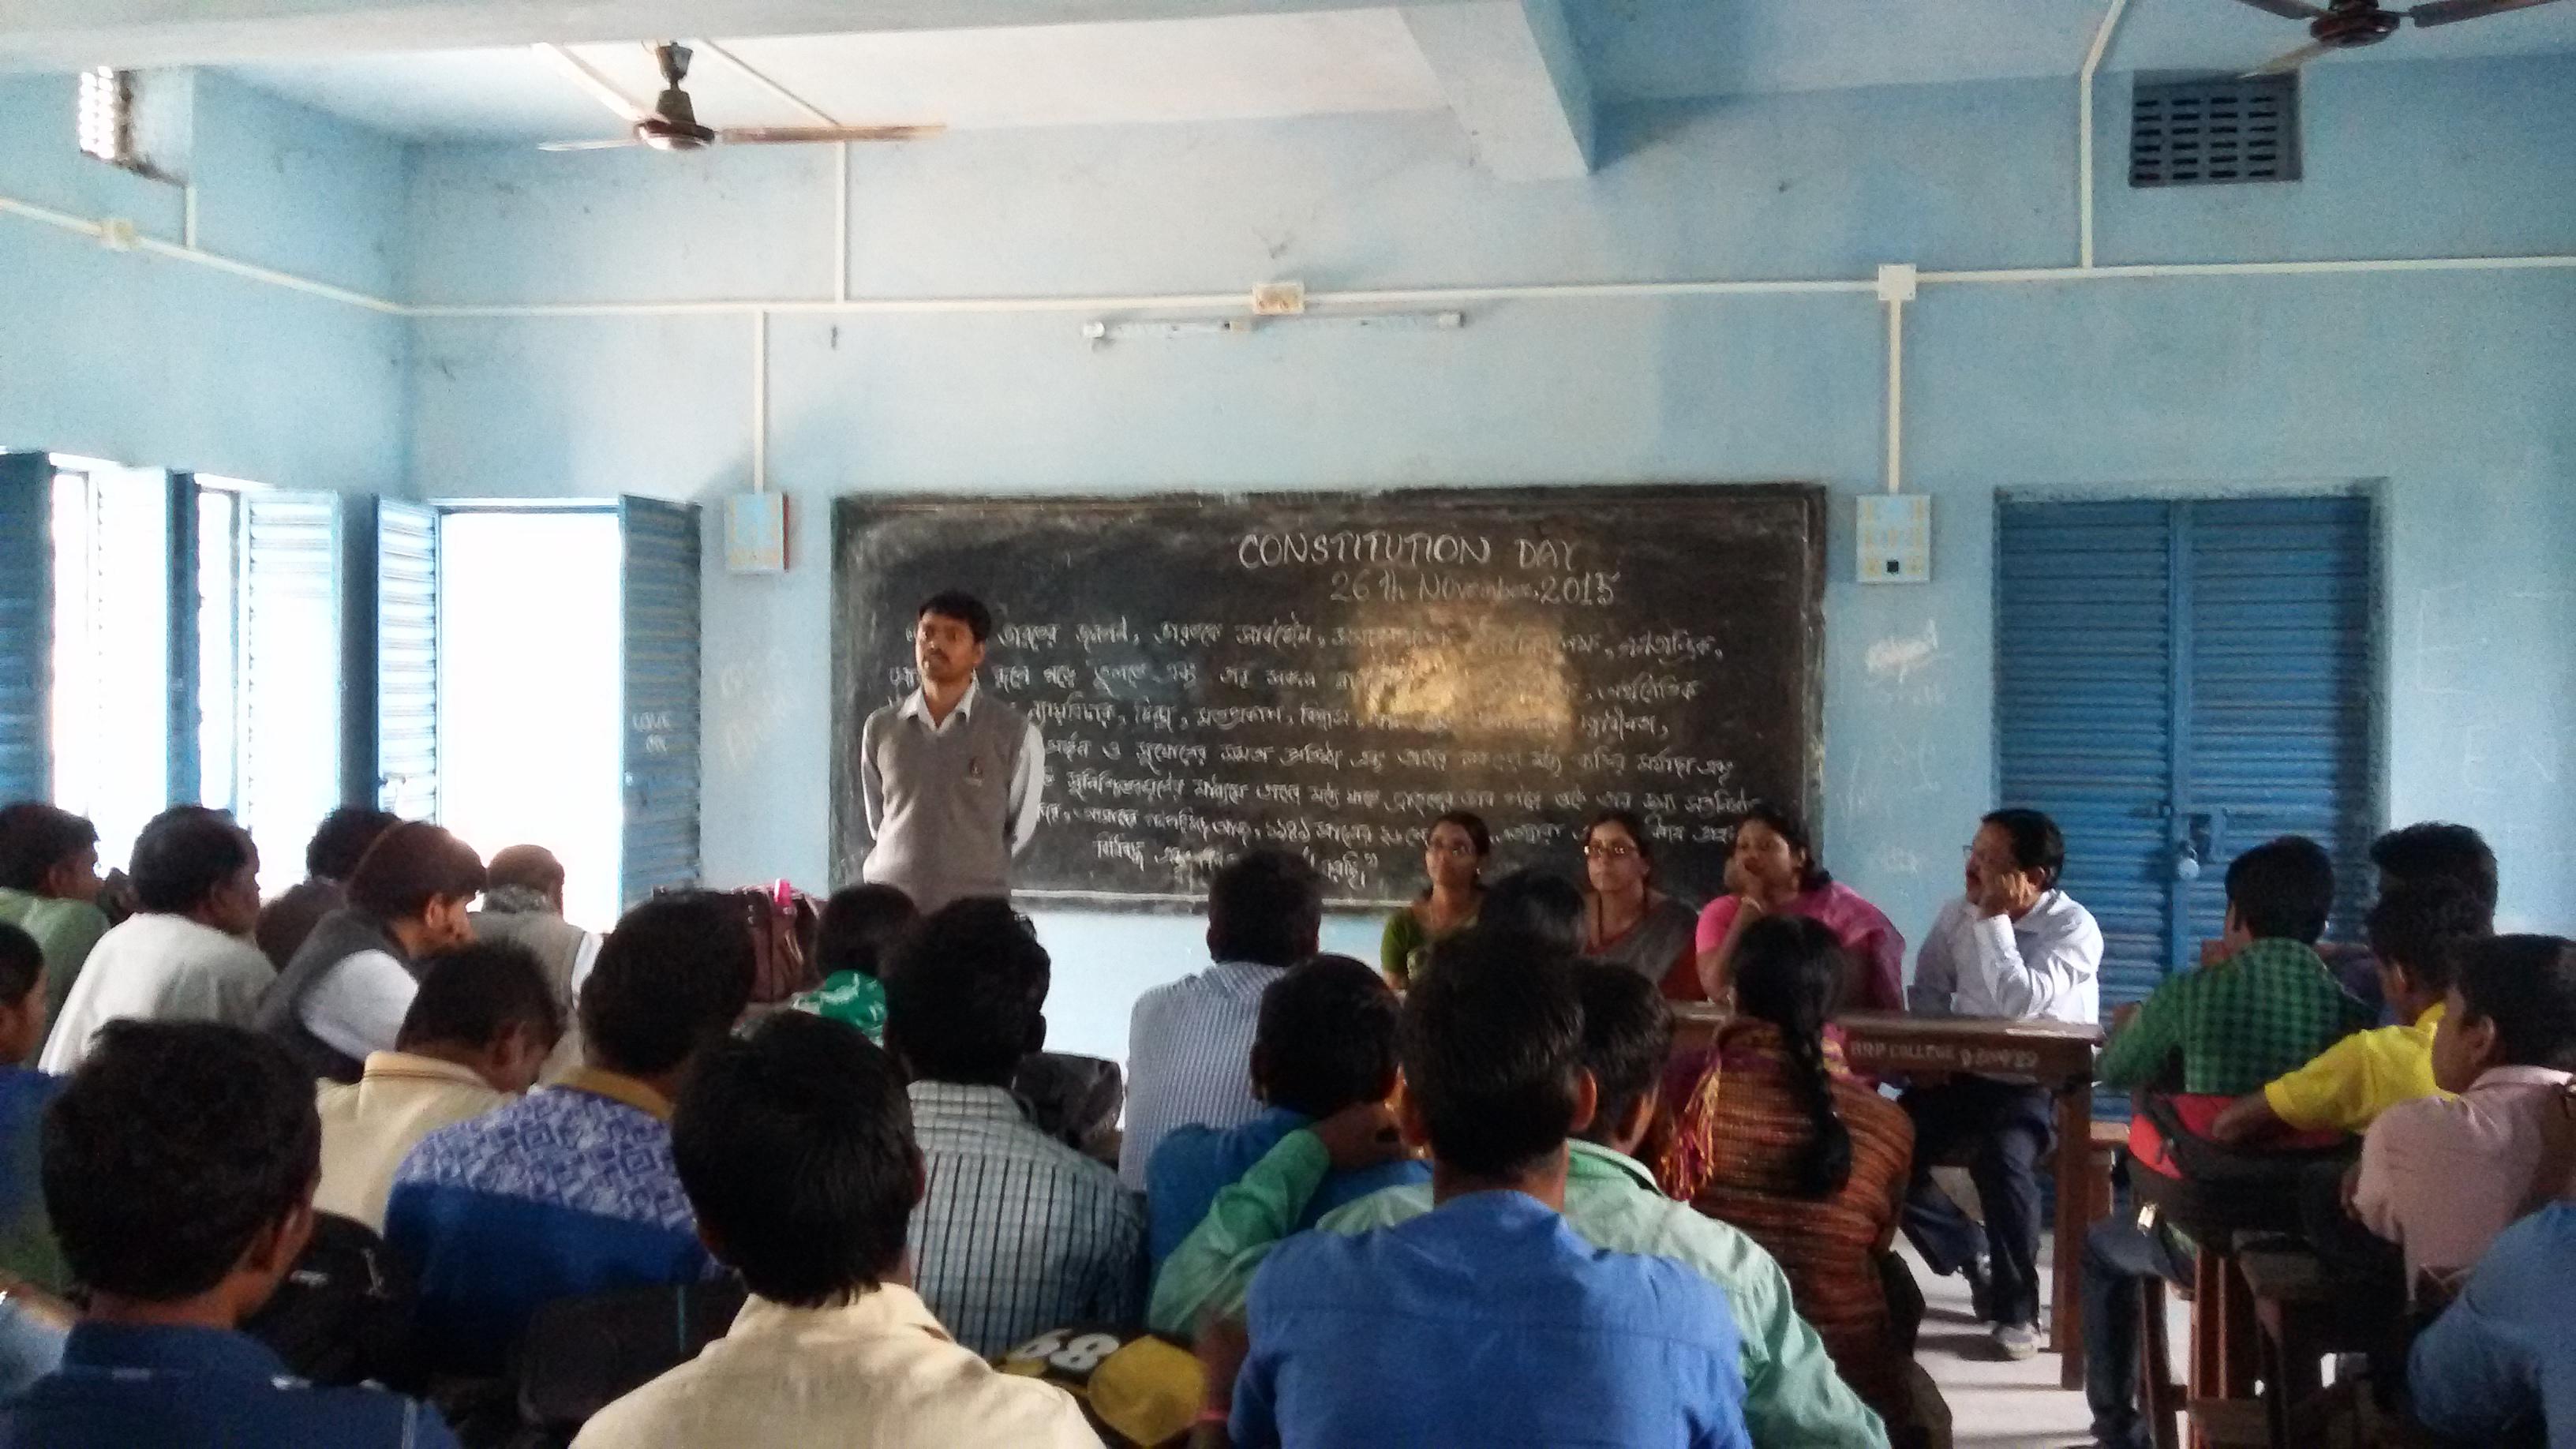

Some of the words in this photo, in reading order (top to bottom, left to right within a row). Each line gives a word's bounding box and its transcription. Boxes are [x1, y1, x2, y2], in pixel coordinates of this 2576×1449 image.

[1238, 532, 1491, 568] CONSTITUTION
[1515, 538, 1577, 571] DAY
[1330, 568, 1371, 602] 26
